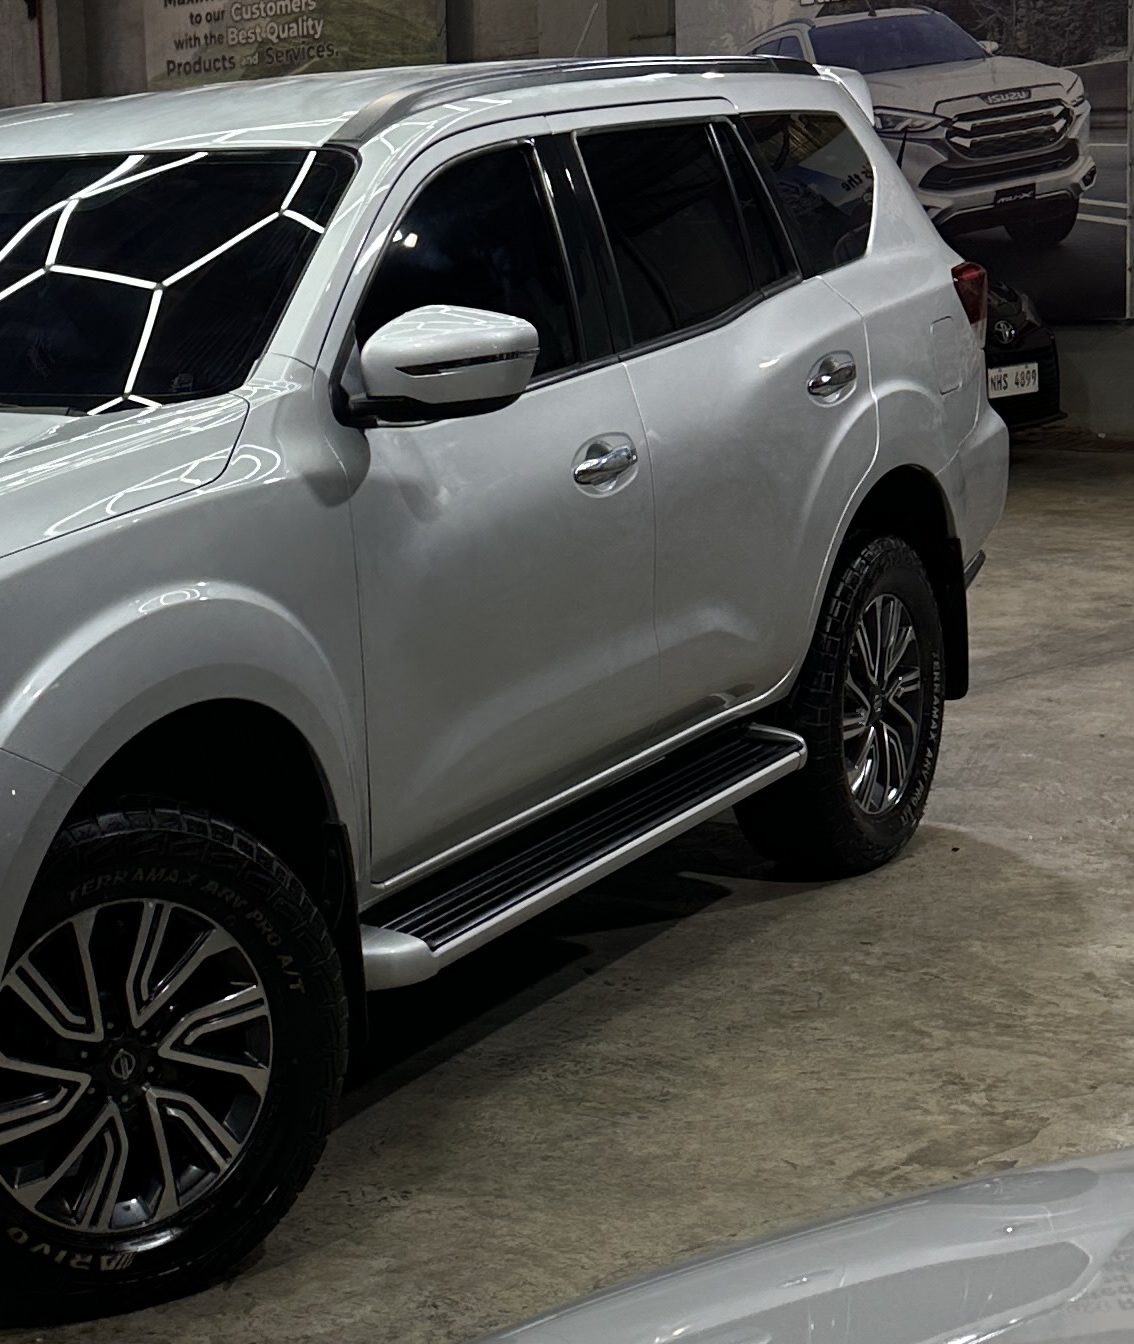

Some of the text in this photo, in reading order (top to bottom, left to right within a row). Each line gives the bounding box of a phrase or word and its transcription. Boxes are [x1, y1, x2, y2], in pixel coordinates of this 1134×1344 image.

[189, 11, 202, 25] to
[205, 9, 226, 24] our
[174, 15, 324, 50] with the Best Quality
[166, 52, 236, 77] Products
[240, 53, 259, 67] and
[987, 89, 1031, 104] ISUZU
[245, 908, 283, 948] PRO
